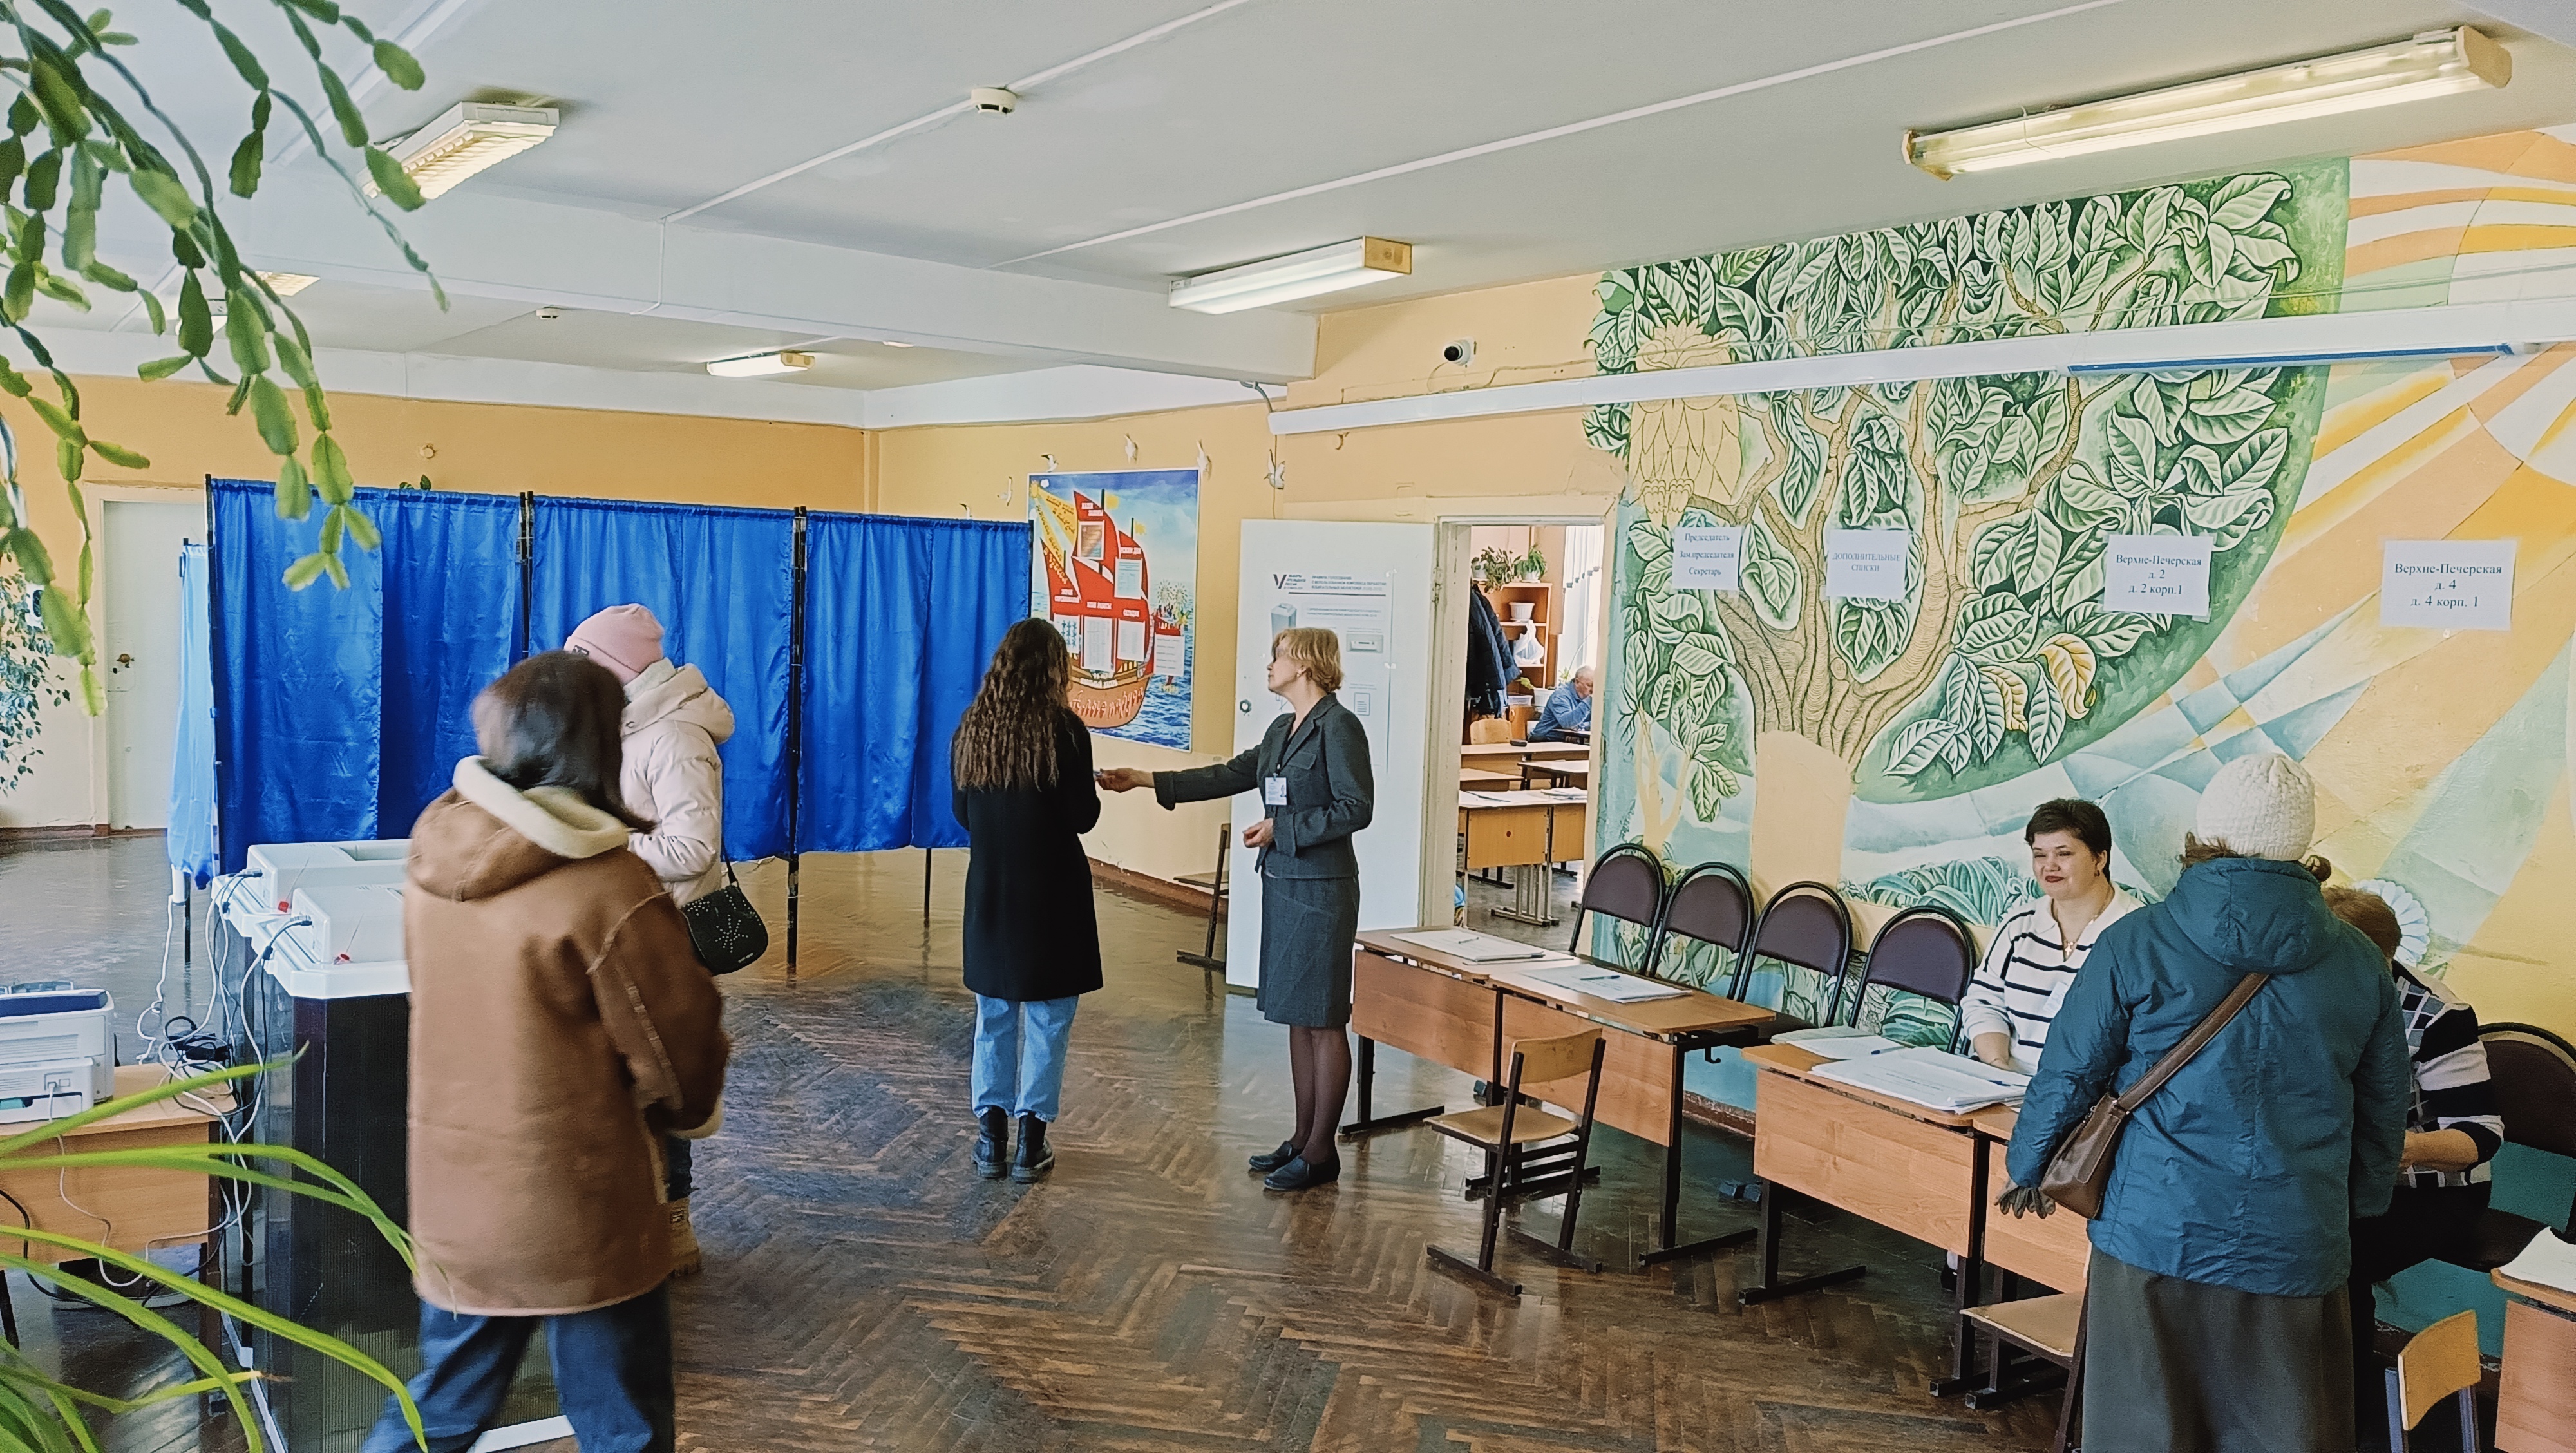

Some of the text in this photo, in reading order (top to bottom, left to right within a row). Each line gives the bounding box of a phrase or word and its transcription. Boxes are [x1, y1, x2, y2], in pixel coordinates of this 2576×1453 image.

[1685, 533, 1730, 542] Председатель
[1832, 553, 1901, 561] ДОПОЛНИТЕЛЬНЫЕ
[2116, 554, 2202, 567] Верхне-Печерская
[1689, 567, 1721, 576] Секретарь
[2159, 569, 2165, 579] 2
[2395, 563, 2502, 576] Верхне-Печерская
[2141, 583, 2146, 593] 2
[2434, 580, 2456, 591] д. 4
[2425, 595, 2432, 606] 4
[2436, 599, 2467, 609] корп.
[2474, 596, 2477, 607] 1
